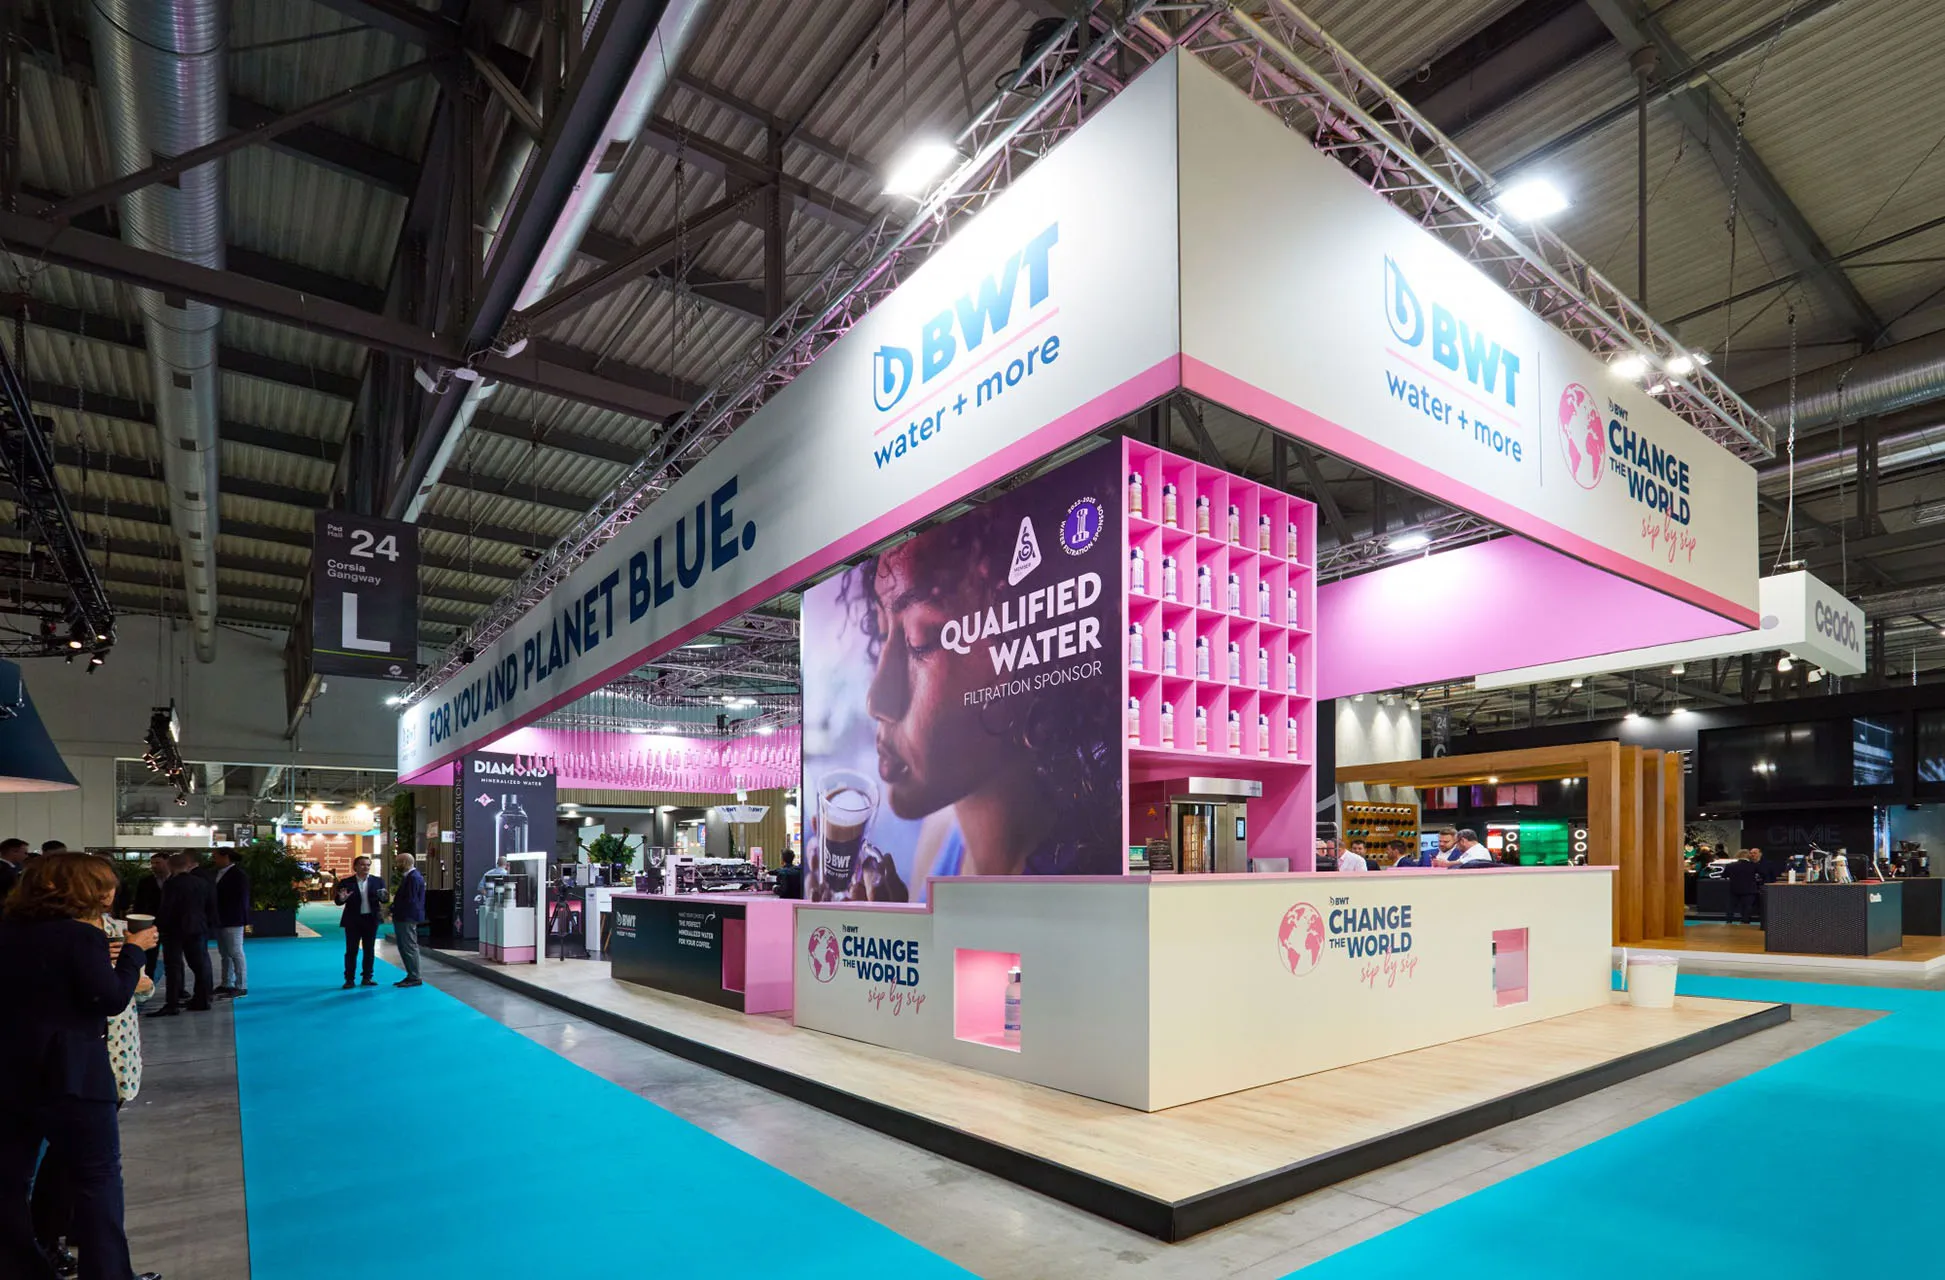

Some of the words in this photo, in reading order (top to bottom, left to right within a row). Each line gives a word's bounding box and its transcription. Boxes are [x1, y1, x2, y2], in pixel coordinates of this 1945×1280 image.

[921, 220, 1059, 385] BWT
[1432, 301, 1521, 408] BWT
[874, 406, 946, 470] water
[976, 335, 1061, 408] more
[1385, 369, 1453, 425] water
[1474, 419, 1523, 463] more
[1614, 404, 1628, 421] BWT
[1608, 419, 1690, 496] CHANGE
[1608, 456, 1627, 478] THE
[1627, 466, 1691, 526] WORLD
[327, 530, 344, 538] Hall
[1059, 519, 1067, 547] WATER
[1091, 503, 1105, 543] SPONSOR
[1641, 513, 1660, 553] sip
[1663, 505, 1678, 564] by
[1679, 530, 1697, 564] sip
[327, 523, 344, 532] Pad
[349, 529, 400, 562] 24
[1062, 541, 1094, 557] FILTRATION
[327, 558, 367, 573] Corsia
[327, 568, 382, 586] Gangway
[1013, 562, 1032, 572] MEMBER
[341, 591, 391, 653] L
[428, 702, 451, 748] FOR
[453, 678, 481, 733] YOU
[483, 652, 518, 717] AND
[523, 568, 620, 692] PLANET
[629, 476, 757, 625] BLUE.
[940, 572, 1102, 655] QUALIFIED
[1815, 599, 1860, 654] ceado.
[988, 616, 1103, 676] WATER
[963, 677, 1031, 707] FILTRATION
[1034, 660, 1103, 690] SPONSOR
[1436, 715, 1448, 729] 24
[239, 838, 250, 848] K
[455, 847, 462, 862] OF
[832, 854, 851, 869] BWT
[1335, 897, 1349, 905] BWT
[622, 914, 636, 927] BWT
[1328, 904, 1412, 934] CHANGE
[842, 935, 919, 964] CHANGE
[1328, 938, 1346, 949] THE
[1346, 932, 1412, 958] WORLD
[842, 958, 856, 969] THE
[857, 960, 920, 987] WORLD
[1360, 961, 1381, 989] sip
[1383, 945, 1398, 988] by
[1400, 953, 1419, 979] sip
[868, 986, 886, 1011] sip
[889, 976, 903, 1017] by
[906, 988, 927, 1015] sip
